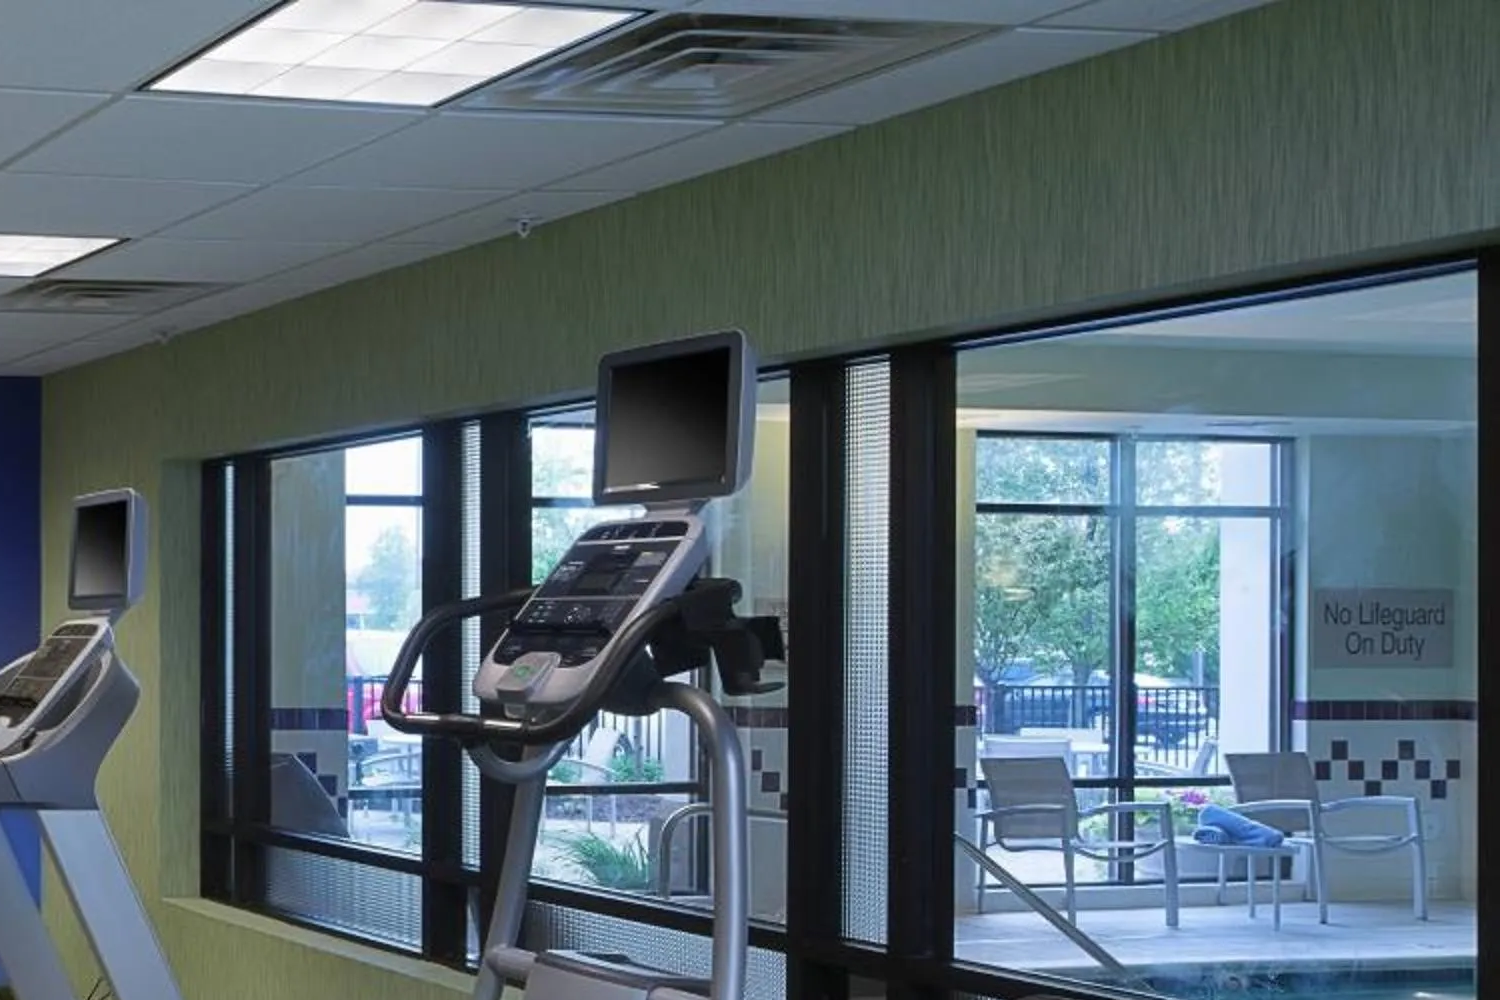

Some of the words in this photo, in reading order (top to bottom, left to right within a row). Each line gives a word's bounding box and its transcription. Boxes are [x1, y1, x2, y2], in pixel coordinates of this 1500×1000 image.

[1324, 602, 1352, 625] No
[1358, 602, 1446, 631] Lifeguard
[1345, 631, 1374, 655] On
[1381, 631, 1426, 661] Duty
